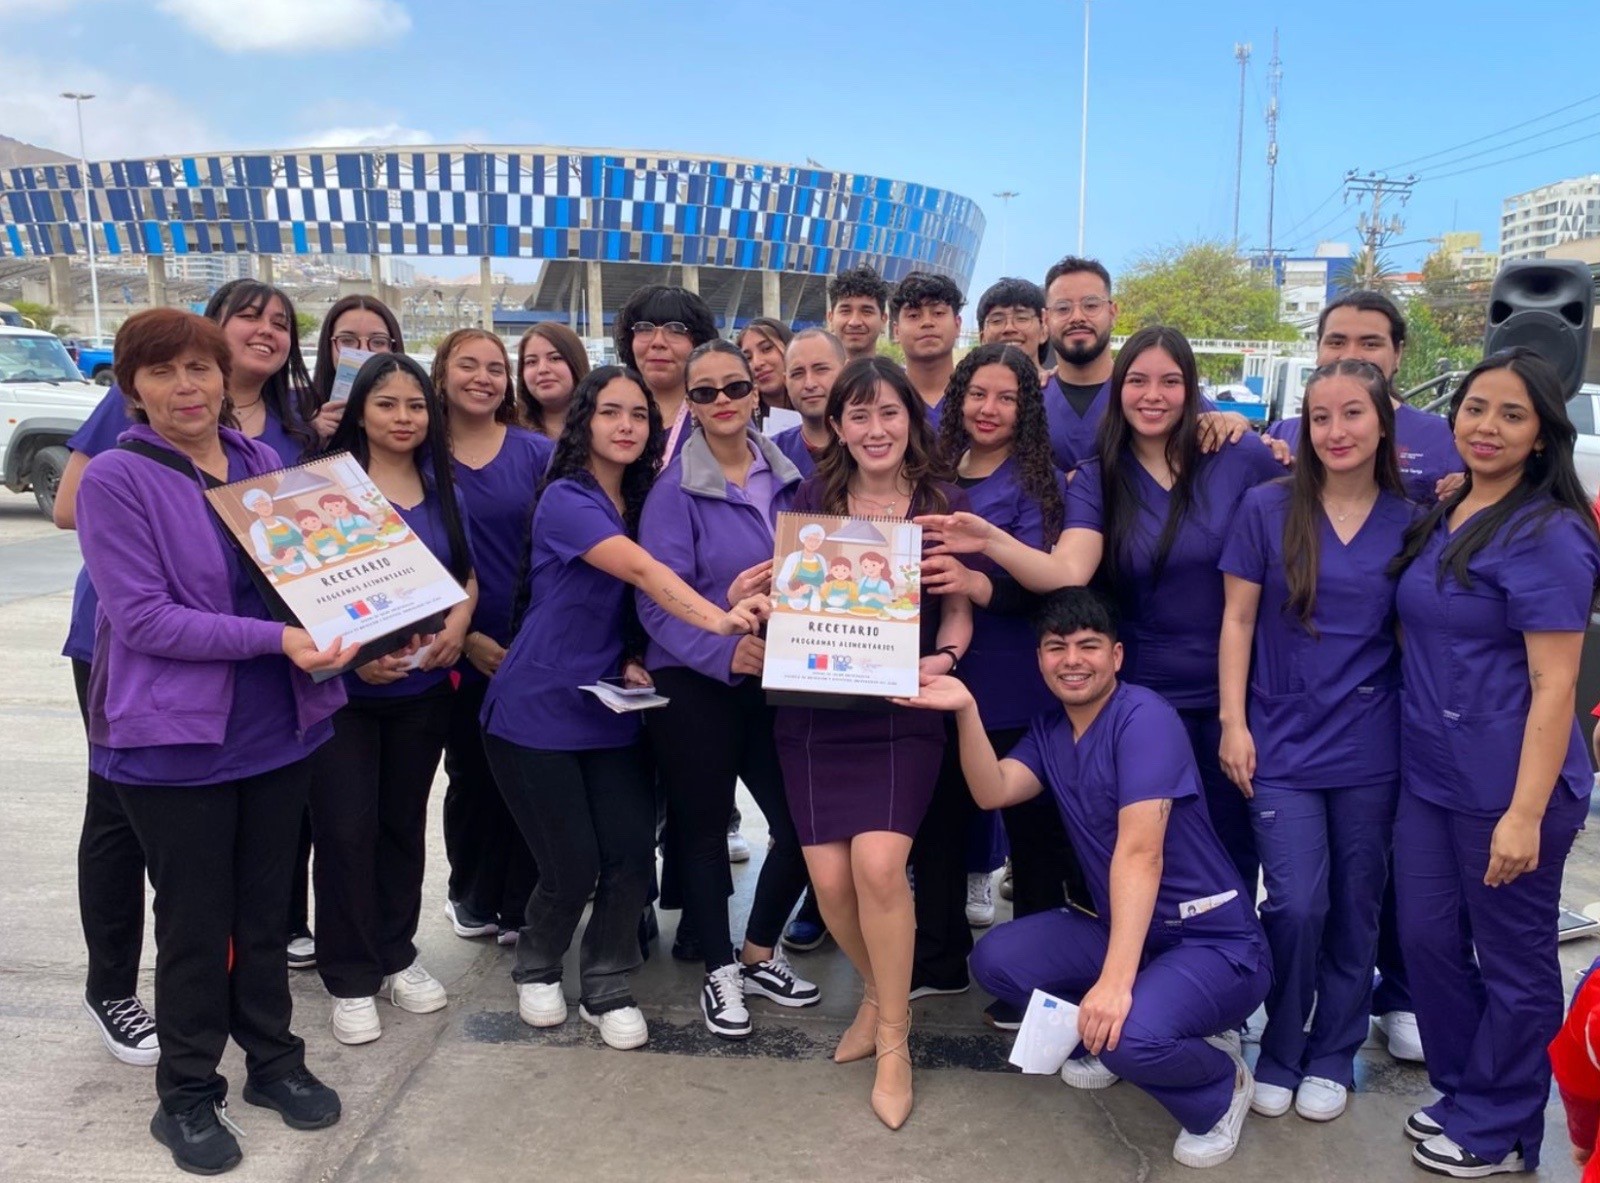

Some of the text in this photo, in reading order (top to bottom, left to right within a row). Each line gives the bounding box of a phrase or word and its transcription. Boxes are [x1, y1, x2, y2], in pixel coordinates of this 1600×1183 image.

[321, 557, 391, 587] RECETARIO
[316, 567, 416, 604] PROGRAMAS ALIMENTARIOS
[809, 621, 880, 637] RECETARIO
[791, 637, 895, 651] PROGRAMAS ALIMENTARIOS
